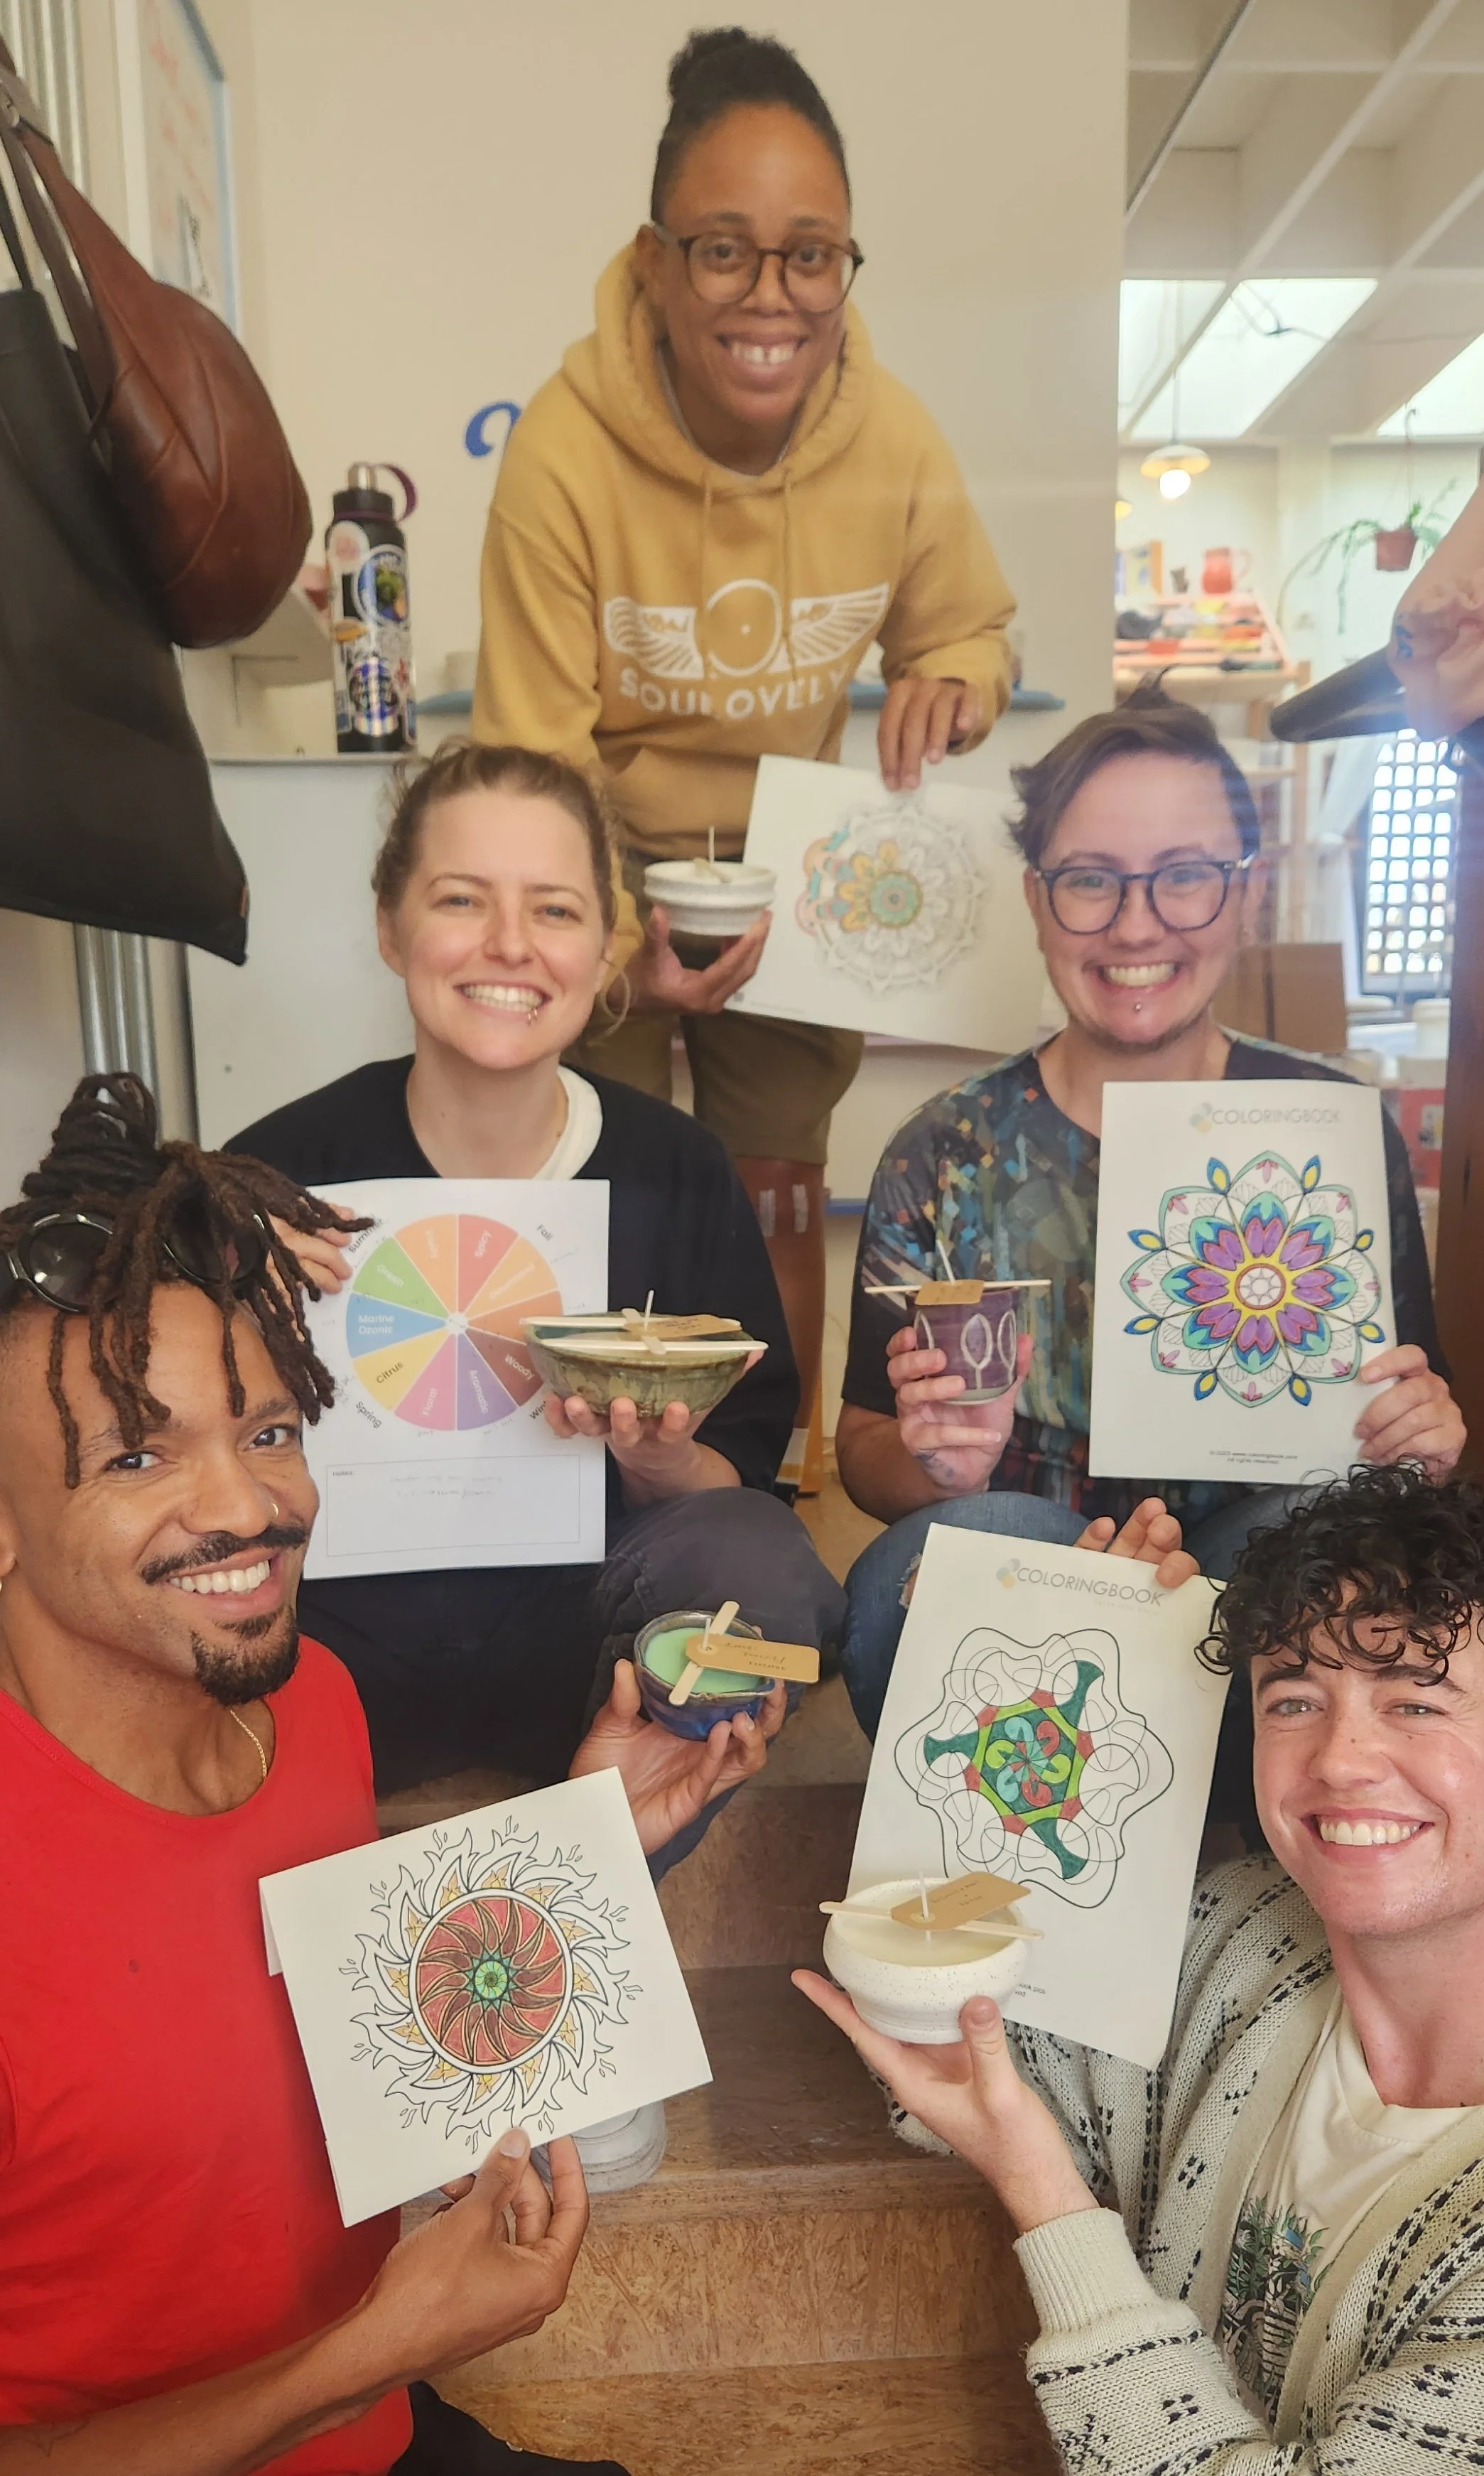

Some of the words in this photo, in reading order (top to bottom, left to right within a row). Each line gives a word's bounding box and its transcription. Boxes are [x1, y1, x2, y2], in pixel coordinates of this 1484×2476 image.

[1212, 1108, 1341, 1125] COLORINGBOOK
[474, 1229, 492, 1258] Spicy
[536, 1223, 553, 1242] Fall
[358, 1314, 395, 1324] Marine
[358, 1325, 394, 1335] Ozonic
[376, 1361, 404, 1384] Citrus
[504, 1353, 536, 1380] Woody
[423, 1388, 438, 1416] Floral
[470, 1369, 489, 1415] Aromatic
[355, 1401, 382, 1429] Spring
[1017, 1567, 1166, 1607] COLORINGBOOK
